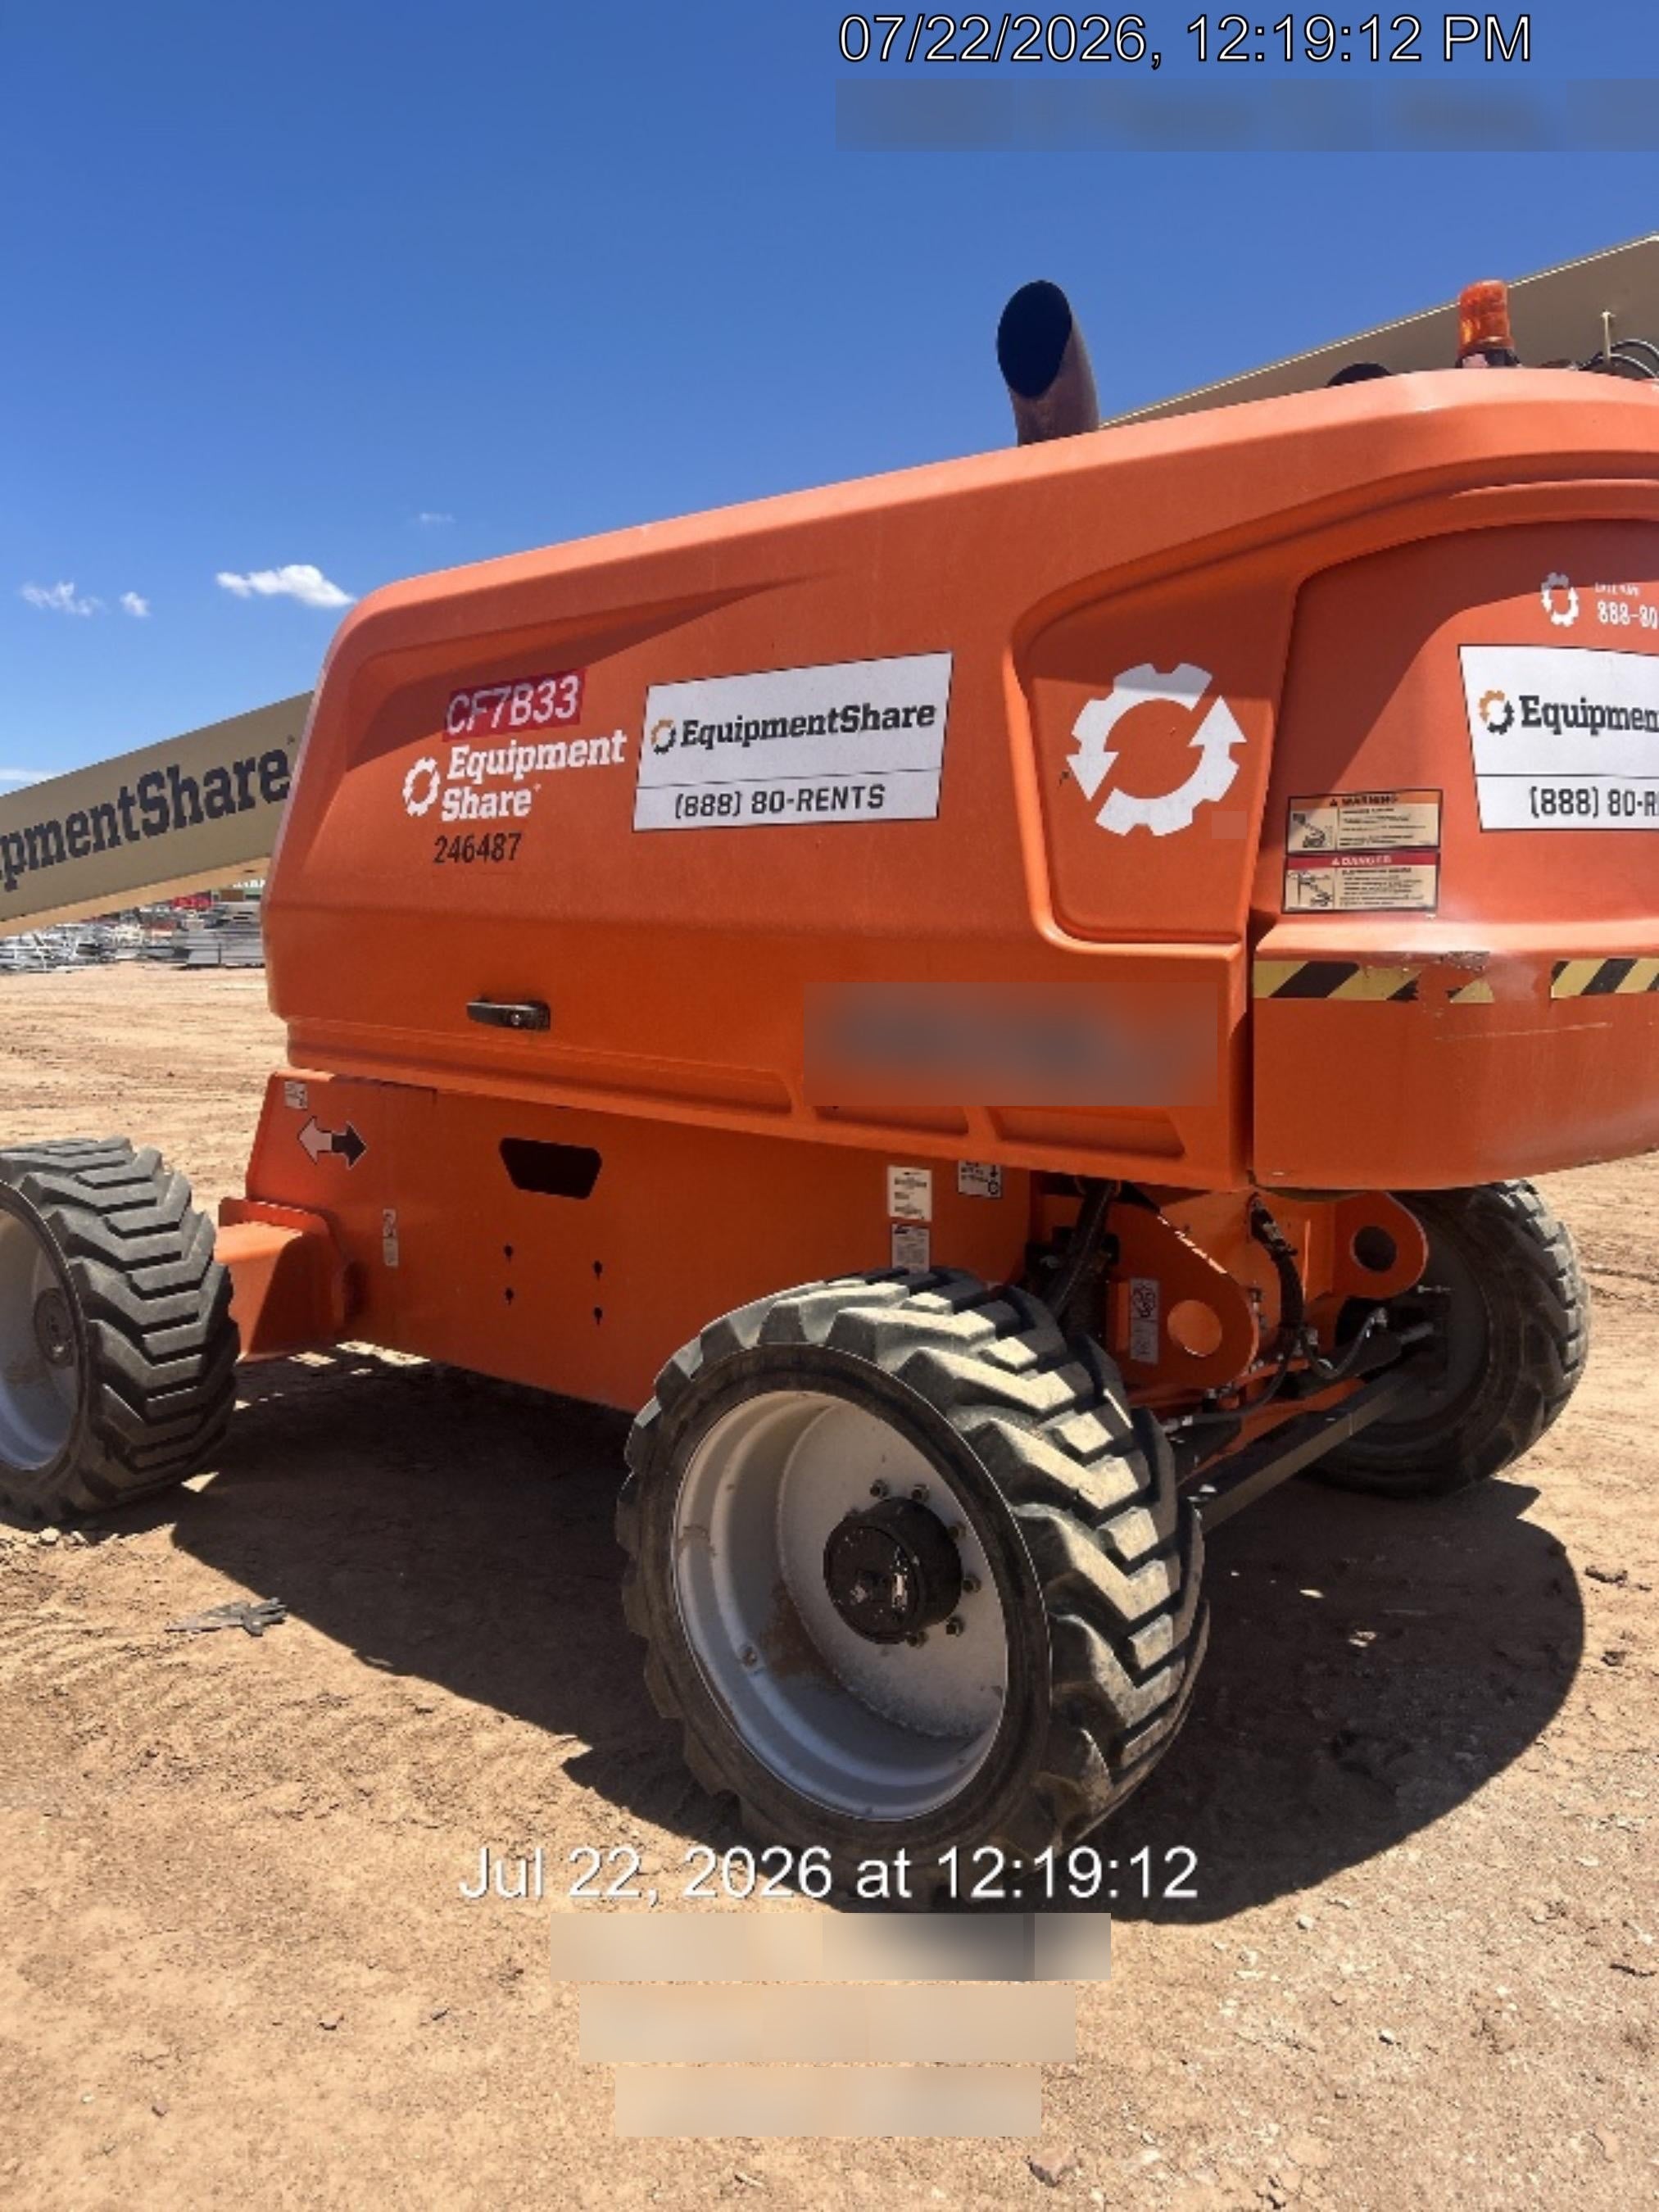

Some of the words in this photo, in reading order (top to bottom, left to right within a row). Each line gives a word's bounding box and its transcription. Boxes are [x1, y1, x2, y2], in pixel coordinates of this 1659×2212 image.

[446, 674, 580, 735] CF7B33
[680, 702, 936, 750] EquipmentShare
[446, 728, 628, 784] Equipment
[0, 748, 291, 892] pmentShare
[441, 786, 533, 822] Share
[673, 790, 742, 819] (888)
[751, 783, 886, 814] 80-RENTS
[1530, 786, 1599, 818] (888)
[1607, 788, 1659, 817] 80-R
[434, 832, 522, 863] 246487
